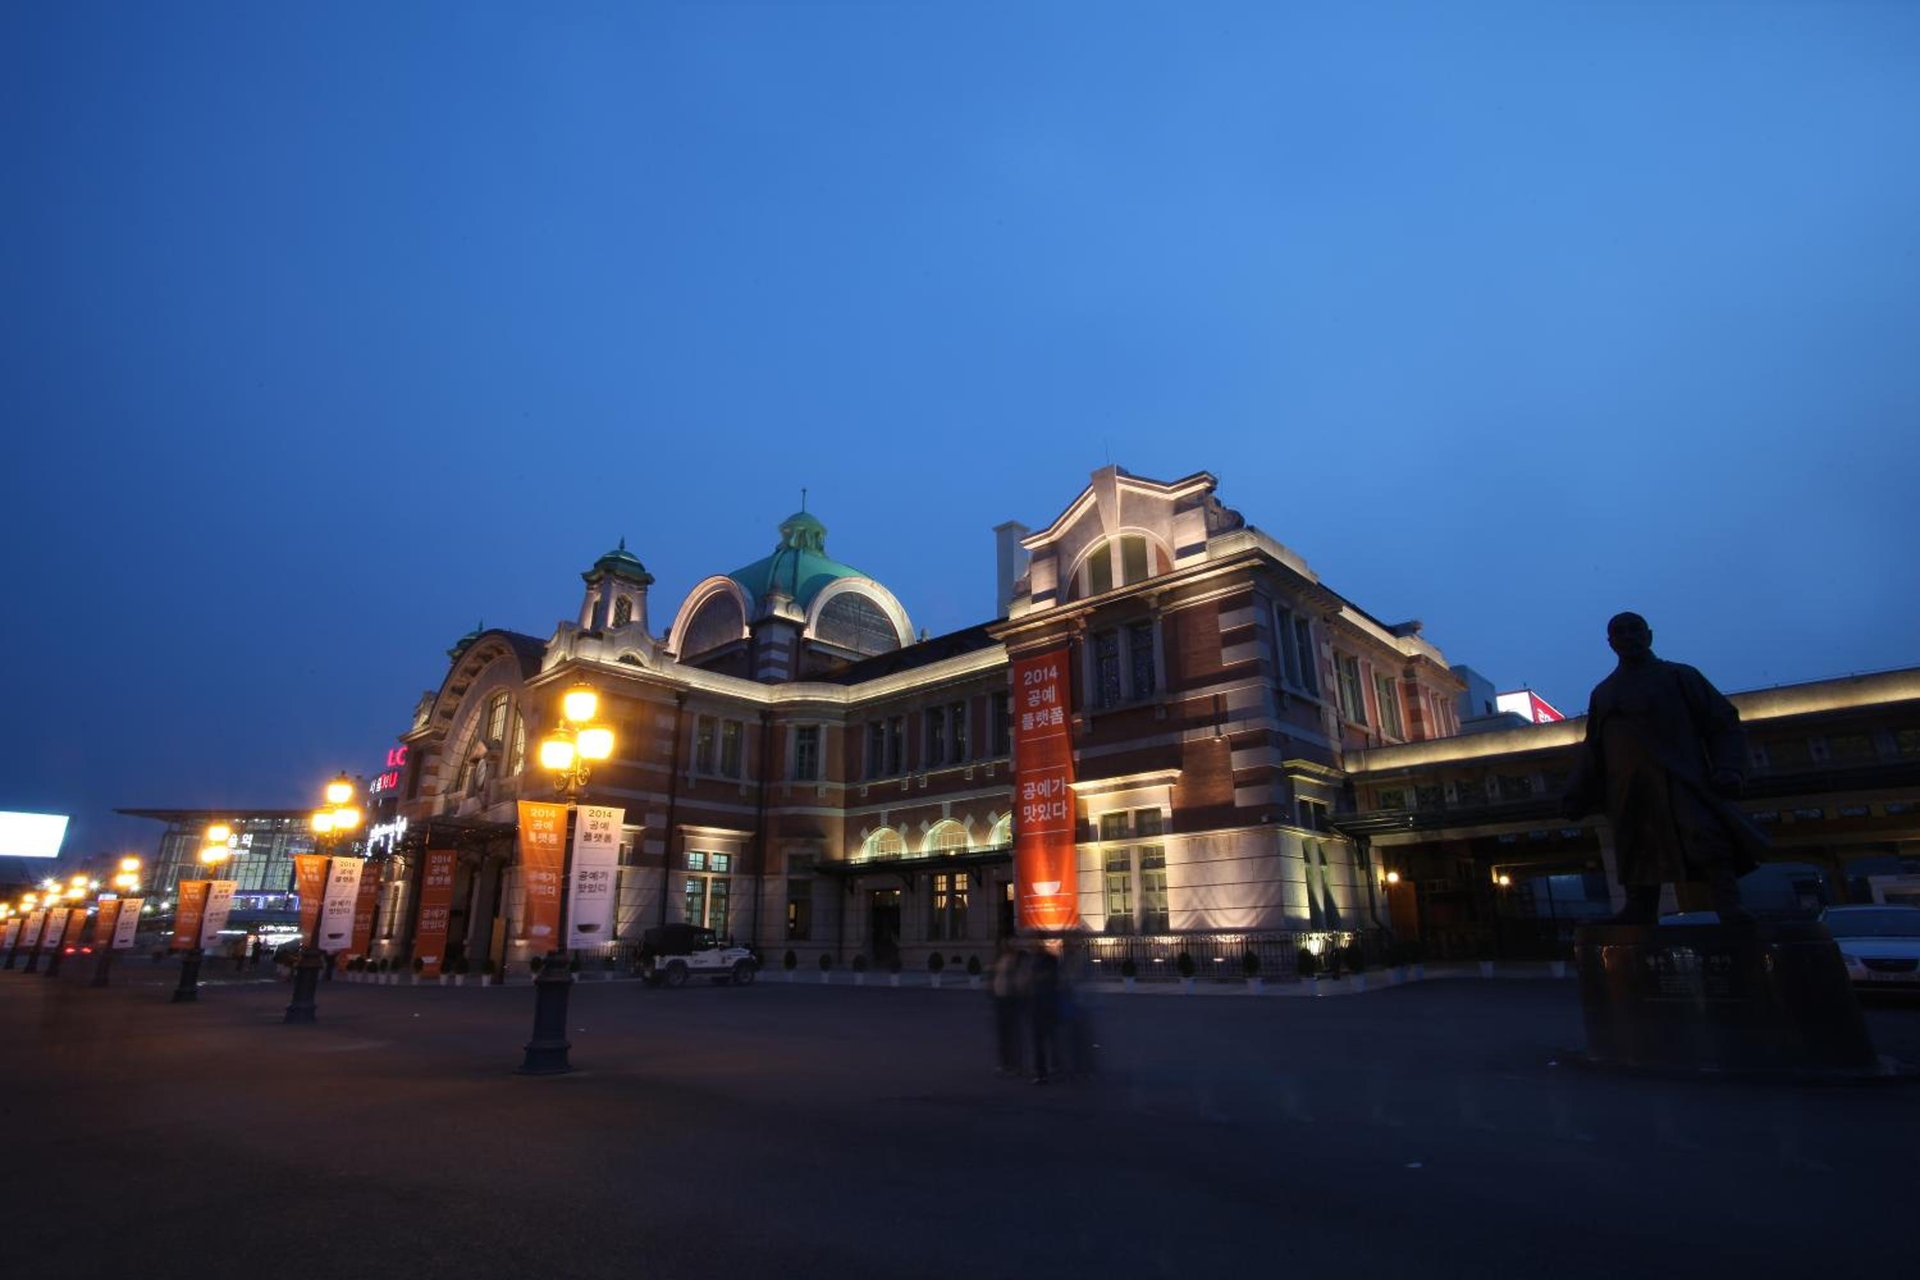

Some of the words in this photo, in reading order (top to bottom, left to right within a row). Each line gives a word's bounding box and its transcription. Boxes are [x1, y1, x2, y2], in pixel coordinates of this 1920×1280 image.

[1024, 665, 1059, 685] 2014
[1028, 685, 1056, 707] 공예
[1022, 706, 1064, 730] 플랫폼
[1023, 777, 1068, 800] 공예가
[588, 808, 612, 819] 2014
[1023, 800, 1068, 823] 맛있다
